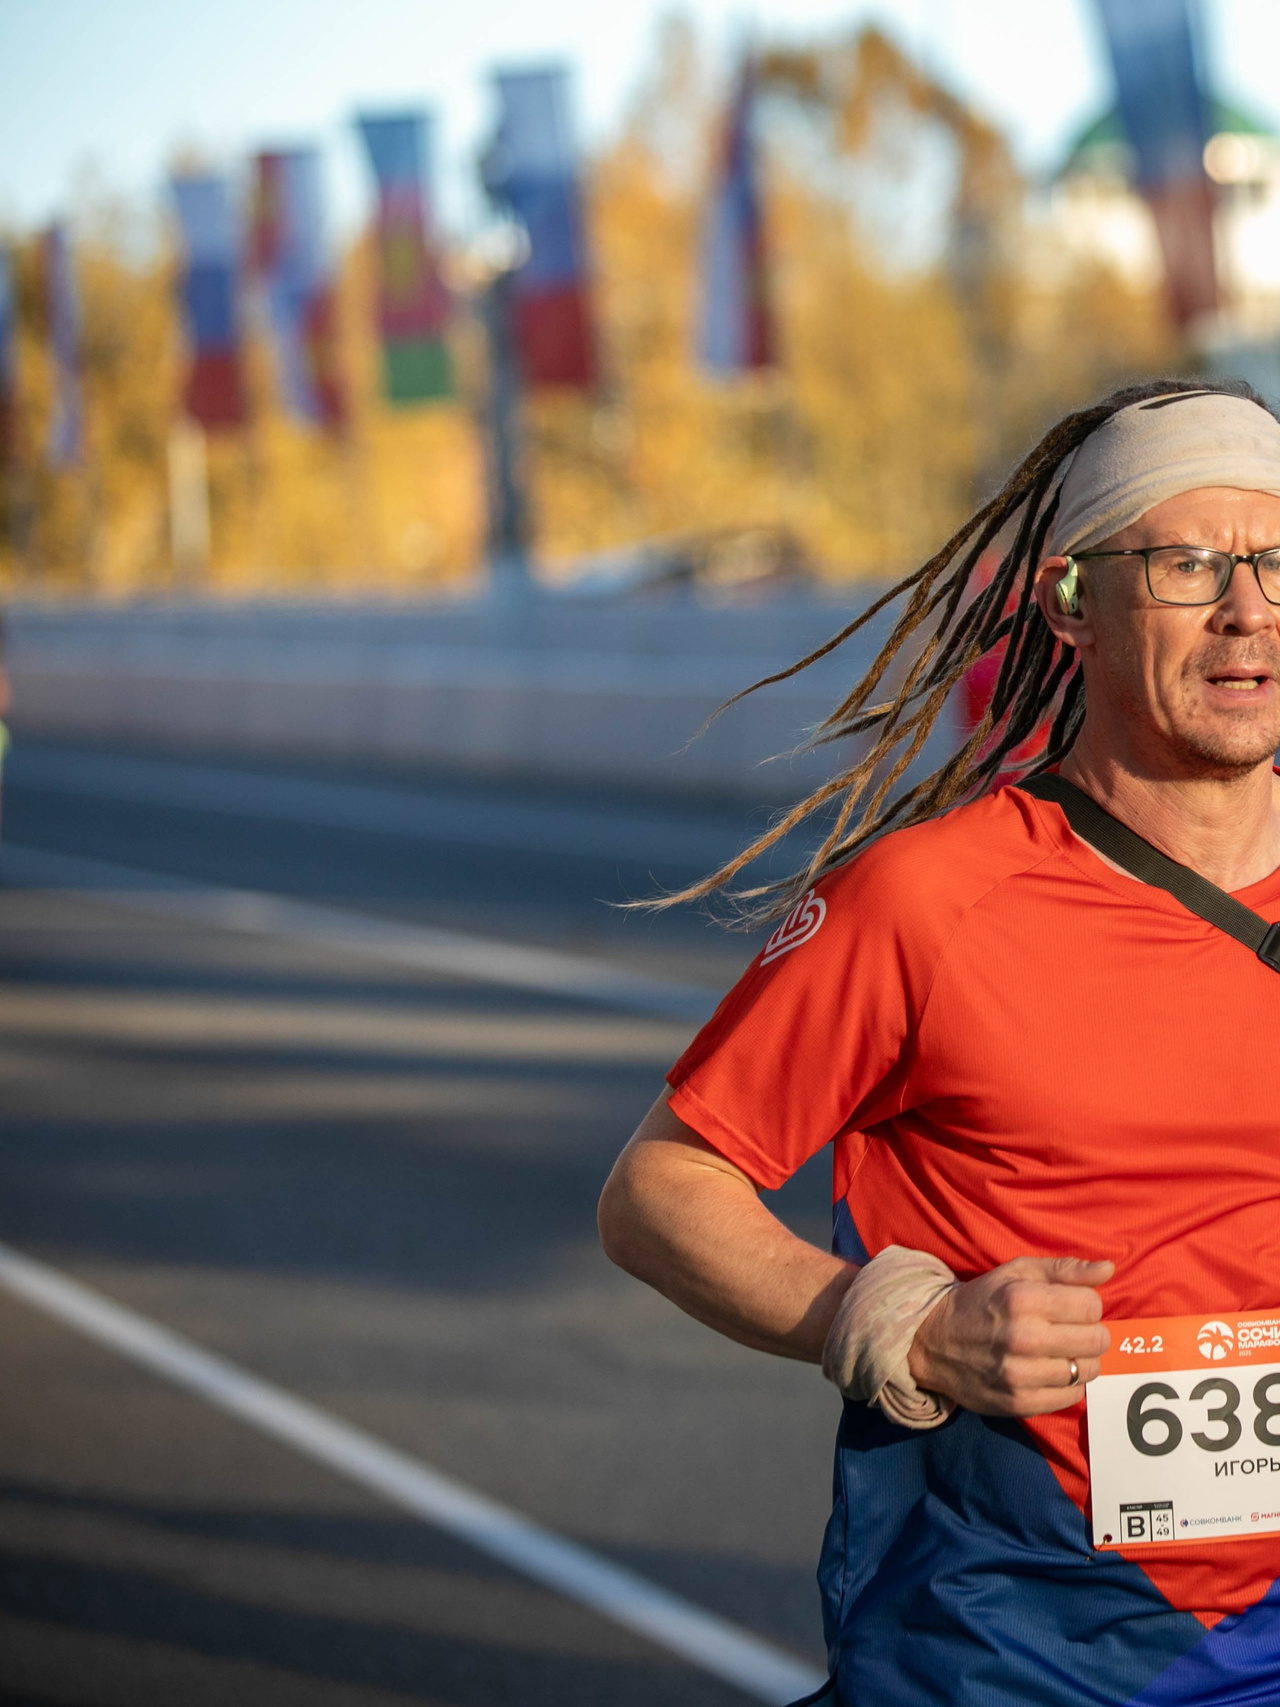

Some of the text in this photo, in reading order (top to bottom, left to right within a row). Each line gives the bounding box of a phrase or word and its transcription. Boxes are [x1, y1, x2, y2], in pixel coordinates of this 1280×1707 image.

[1119, 1335, 1164, 1354] 42.2
[1156, 1514, 1169, 1522] 45
[1189, 1515, 1243, 1526] СОВКОМБАНК
[1156, 1527, 1171, 1537] 49
